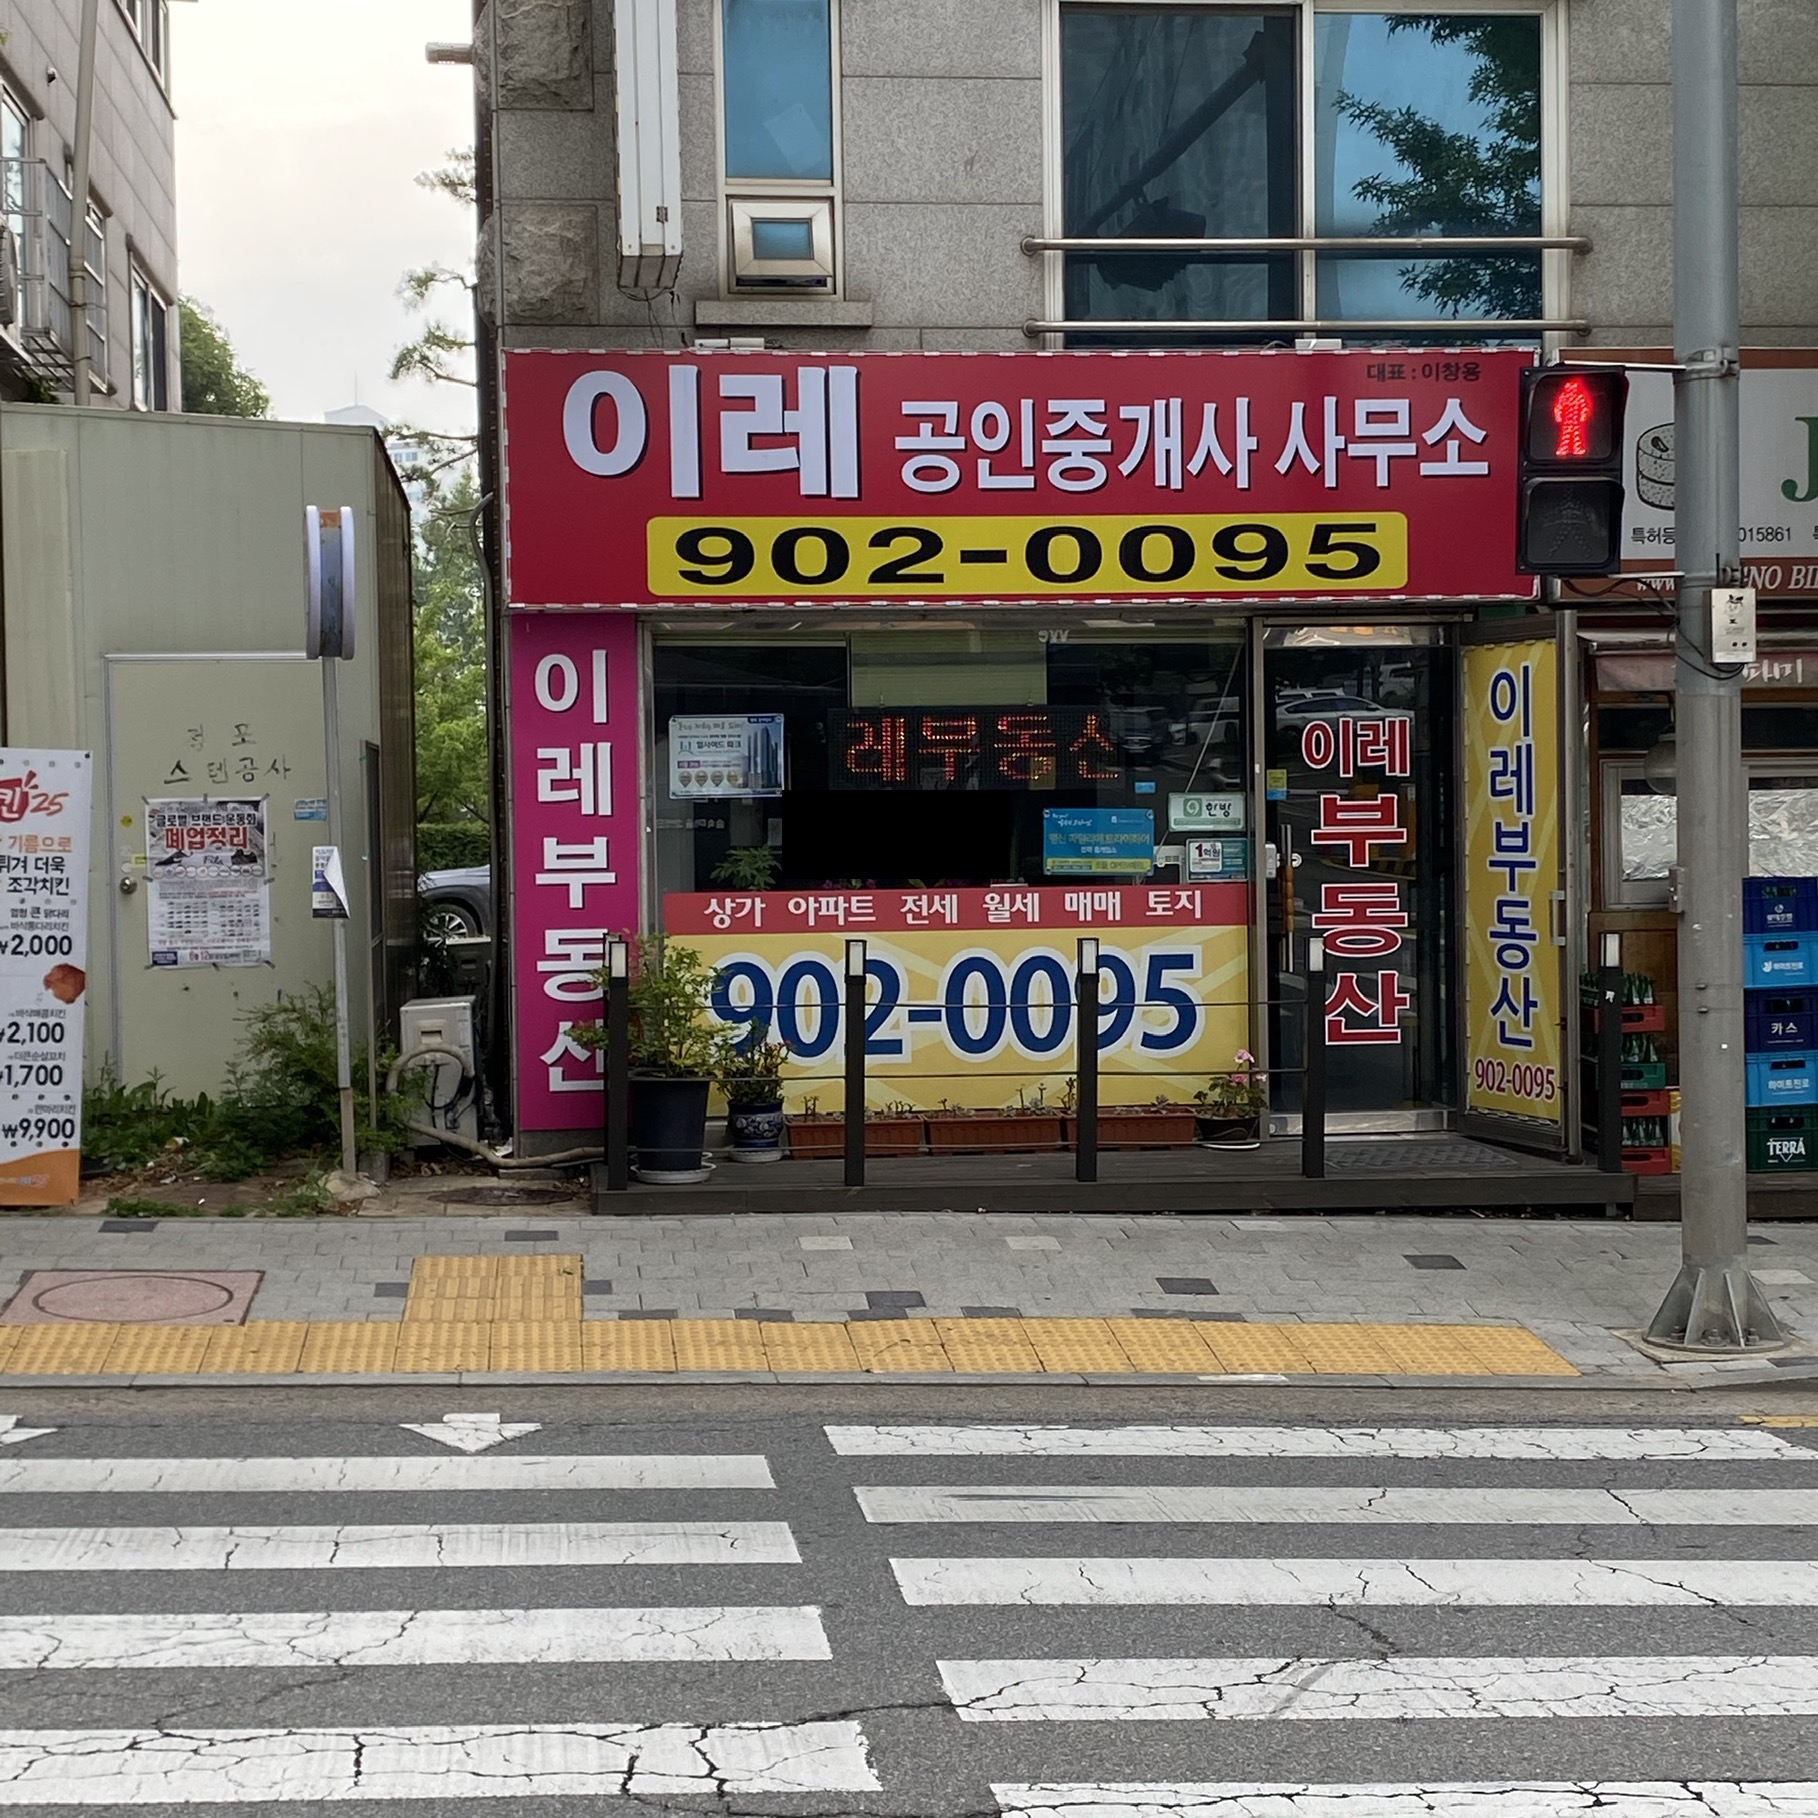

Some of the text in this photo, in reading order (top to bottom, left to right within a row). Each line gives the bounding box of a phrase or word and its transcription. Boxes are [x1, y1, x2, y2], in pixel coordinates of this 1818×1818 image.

[1421, 362, 1481, 382] 이창용
[562, 364, 1489, 499] 이레 공인중개사 사무소
[674, 522, 1382, 586] 902-0095
[1301, 716, 1411, 778] 이레
[156, 813, 257, 828] 글로벌 브랜드 운동화
[8, 834, 73, 854] 기름으로
[165, 826, 248, 850] 폐업정리
[34, 855, 67, 875] 더욱
[1488, 664, 1539, 1049] 이레부동산
[534, 648, 617, 1092] 이레부동산
[6, 876, 70, 897] 조각치킨
[704, 888, 1202, 929] 상가 아파트 전세 월세 매매 토지
[1310, 793, 1410, 1046] 부동산
[710, 952, 1198, 1058] 902-0095
[0, 1020, 65, 1046] 2,100
[0, 1064, 64, 1089] 1,700
[1473, 1057, 1556, 1102] 902-0095
[2, 1117, 76, 1142] ₩9,900
[1766, 1137, 1807, 1157] TERRA
